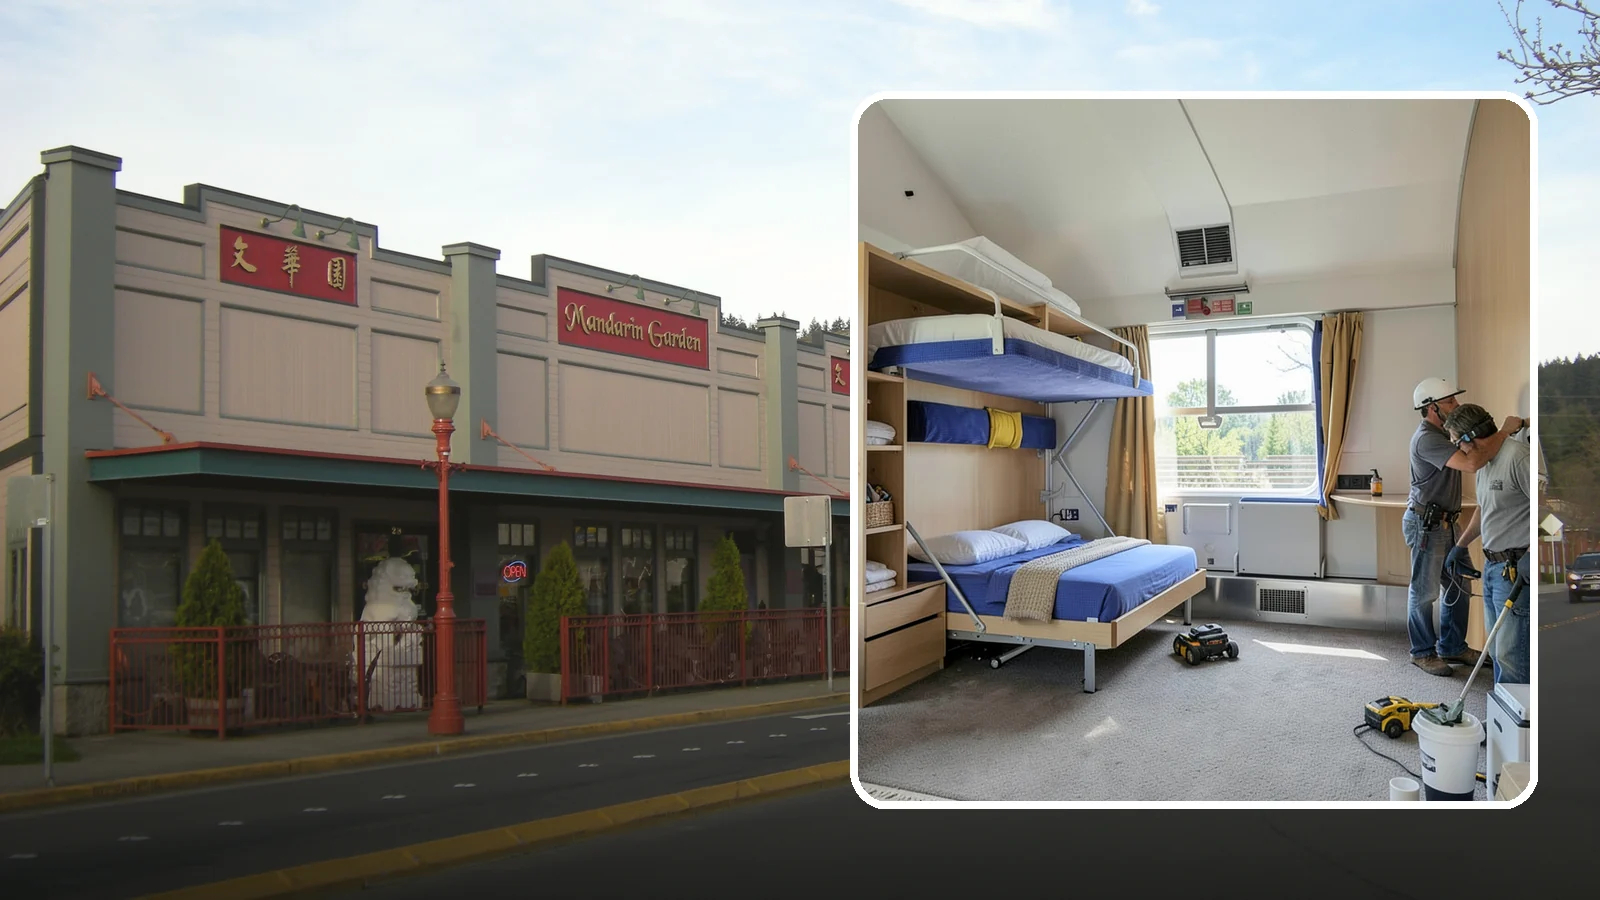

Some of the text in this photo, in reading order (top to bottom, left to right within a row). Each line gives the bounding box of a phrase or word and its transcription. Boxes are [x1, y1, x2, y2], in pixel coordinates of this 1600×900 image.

[231, 235, 346, 291] 文華園
[564, 302, 701, 352] Mandarin Garden
[503, 565, 527, 578] OPEN
